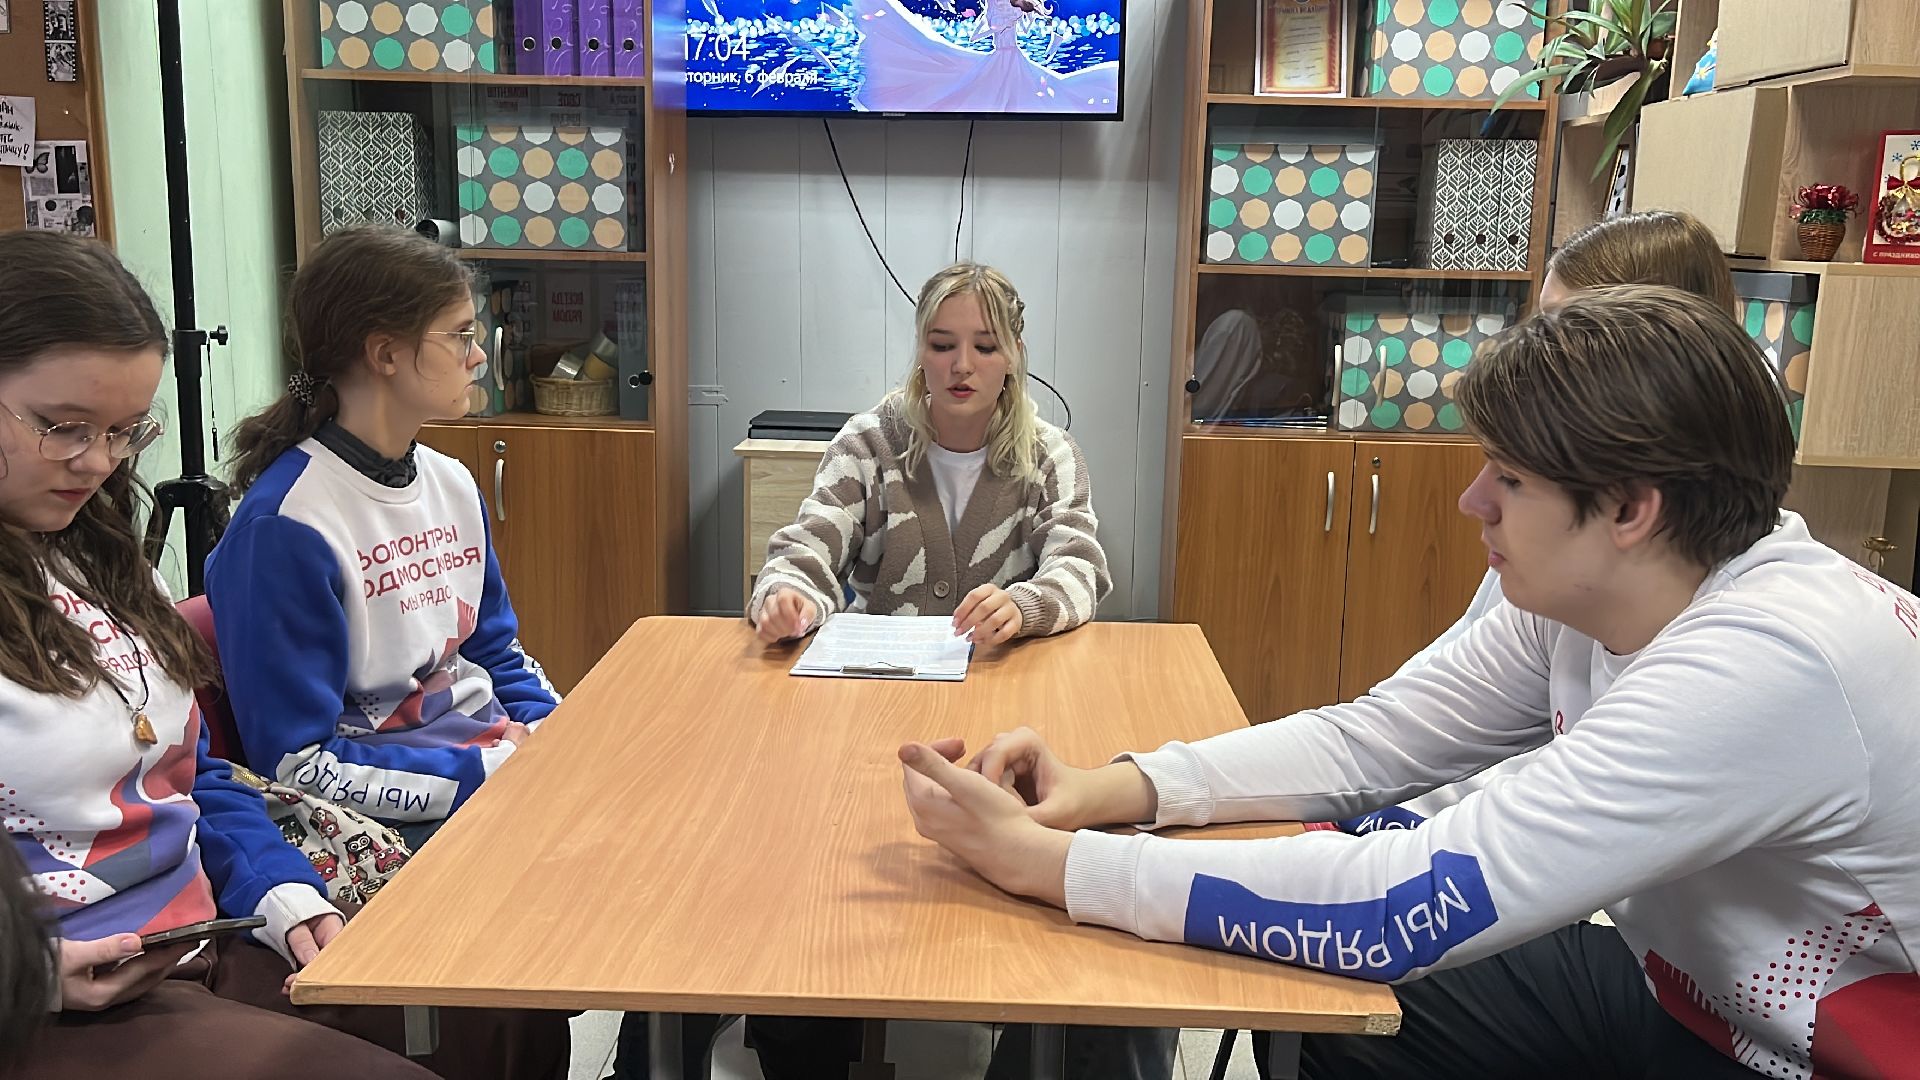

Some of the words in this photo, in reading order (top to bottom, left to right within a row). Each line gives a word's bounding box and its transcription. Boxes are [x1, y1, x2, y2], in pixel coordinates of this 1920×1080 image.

[684, 33, 750, 61] 17:04
[744, 71, 754, 84] 6
[757, 69, 818, 87] февраля
[420, 584, 453, 607] РЯДО
[294, 761, 369, 805] РЯДО
[375, 786, 430, 813] МЫ
[1394, 876, 1471, 952] МЫ
[1218, 915, 1392, 970] РЯДОМ
